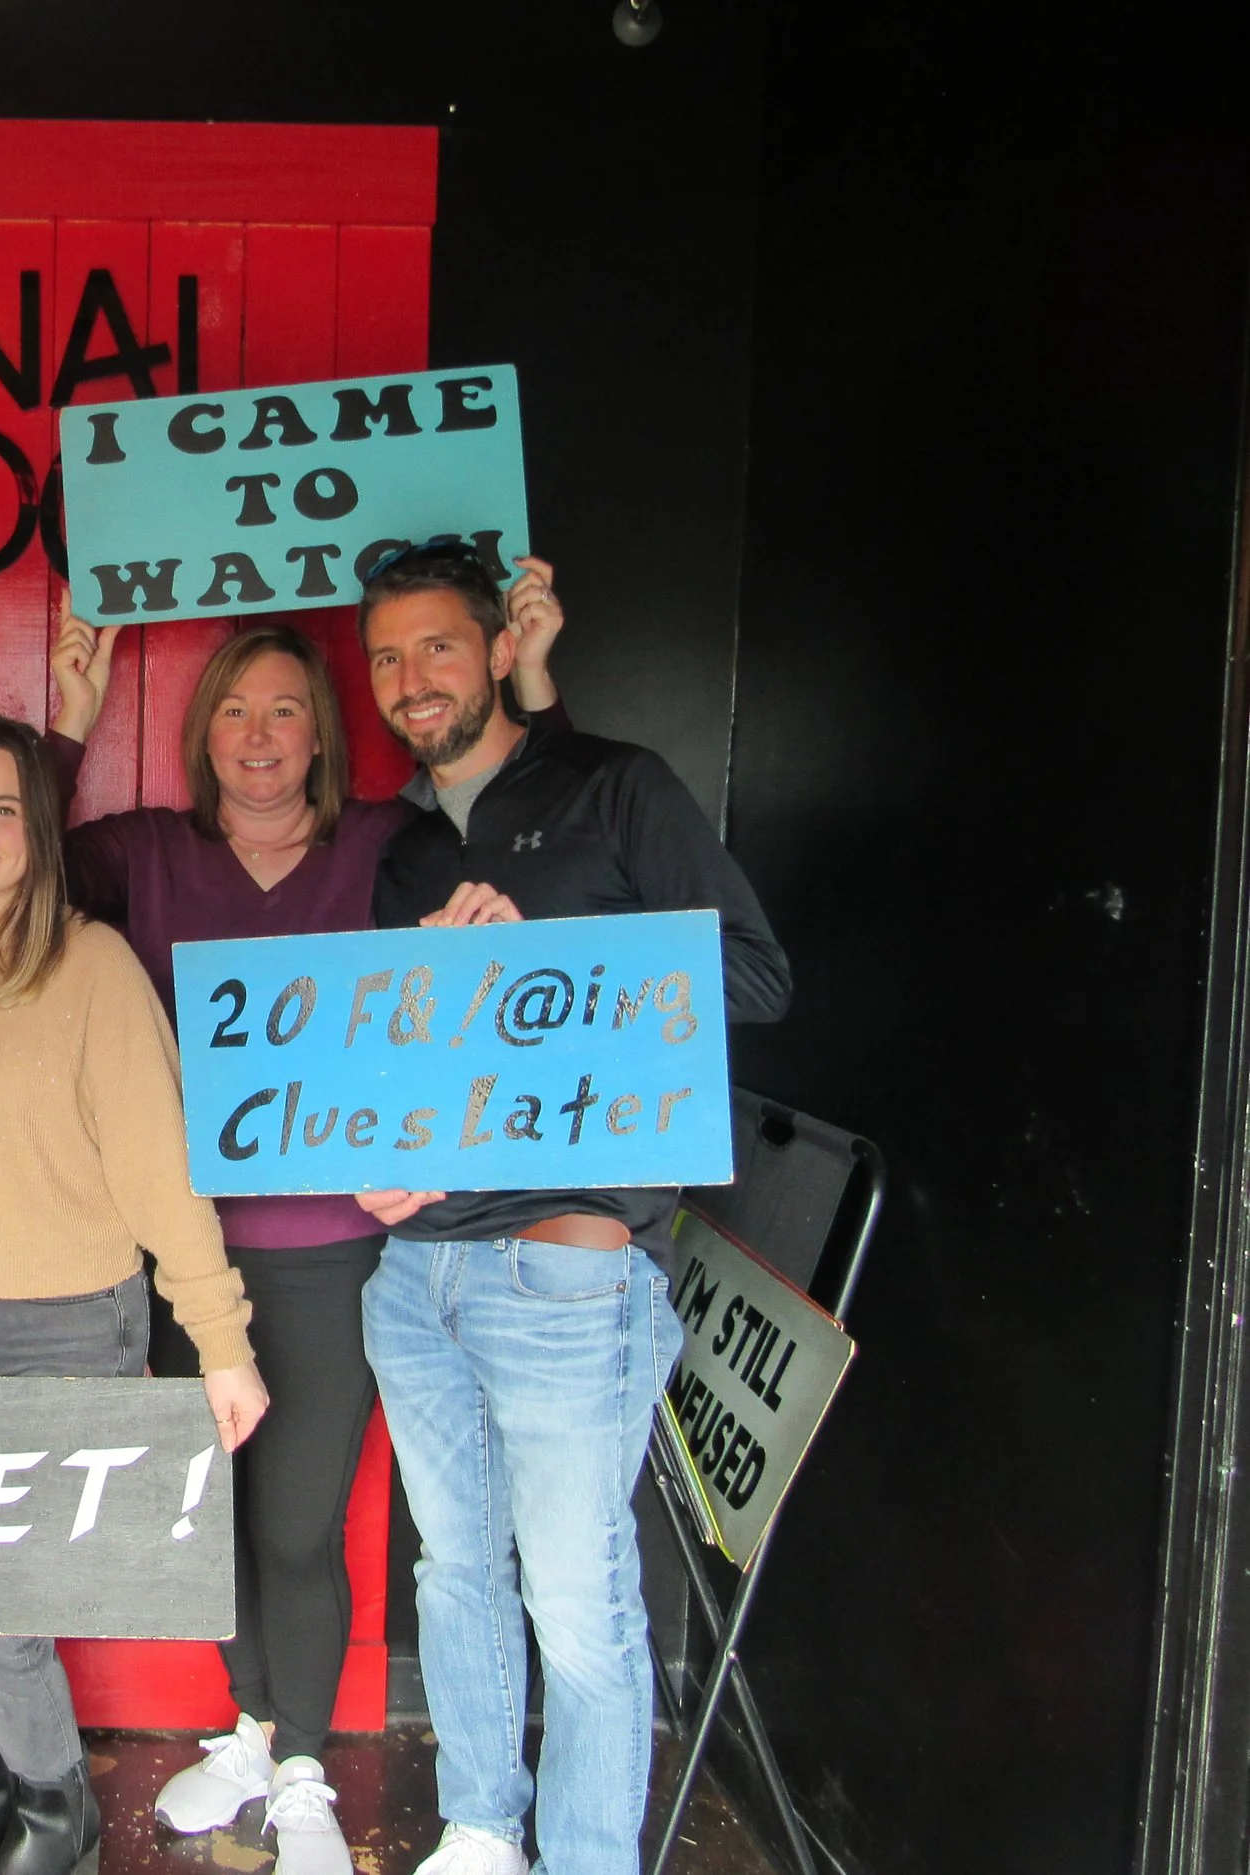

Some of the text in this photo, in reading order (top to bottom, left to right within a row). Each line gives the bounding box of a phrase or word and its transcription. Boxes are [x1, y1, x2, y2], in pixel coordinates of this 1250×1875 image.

[85, 376, 498, 465] I CAME
[225, 467, 359, 526] TO
[209, 975, 317, 1048] 20
[217, 1072, 692, 1162] Clues Later
[673, 1256, 797, 1413] I'M STILL
